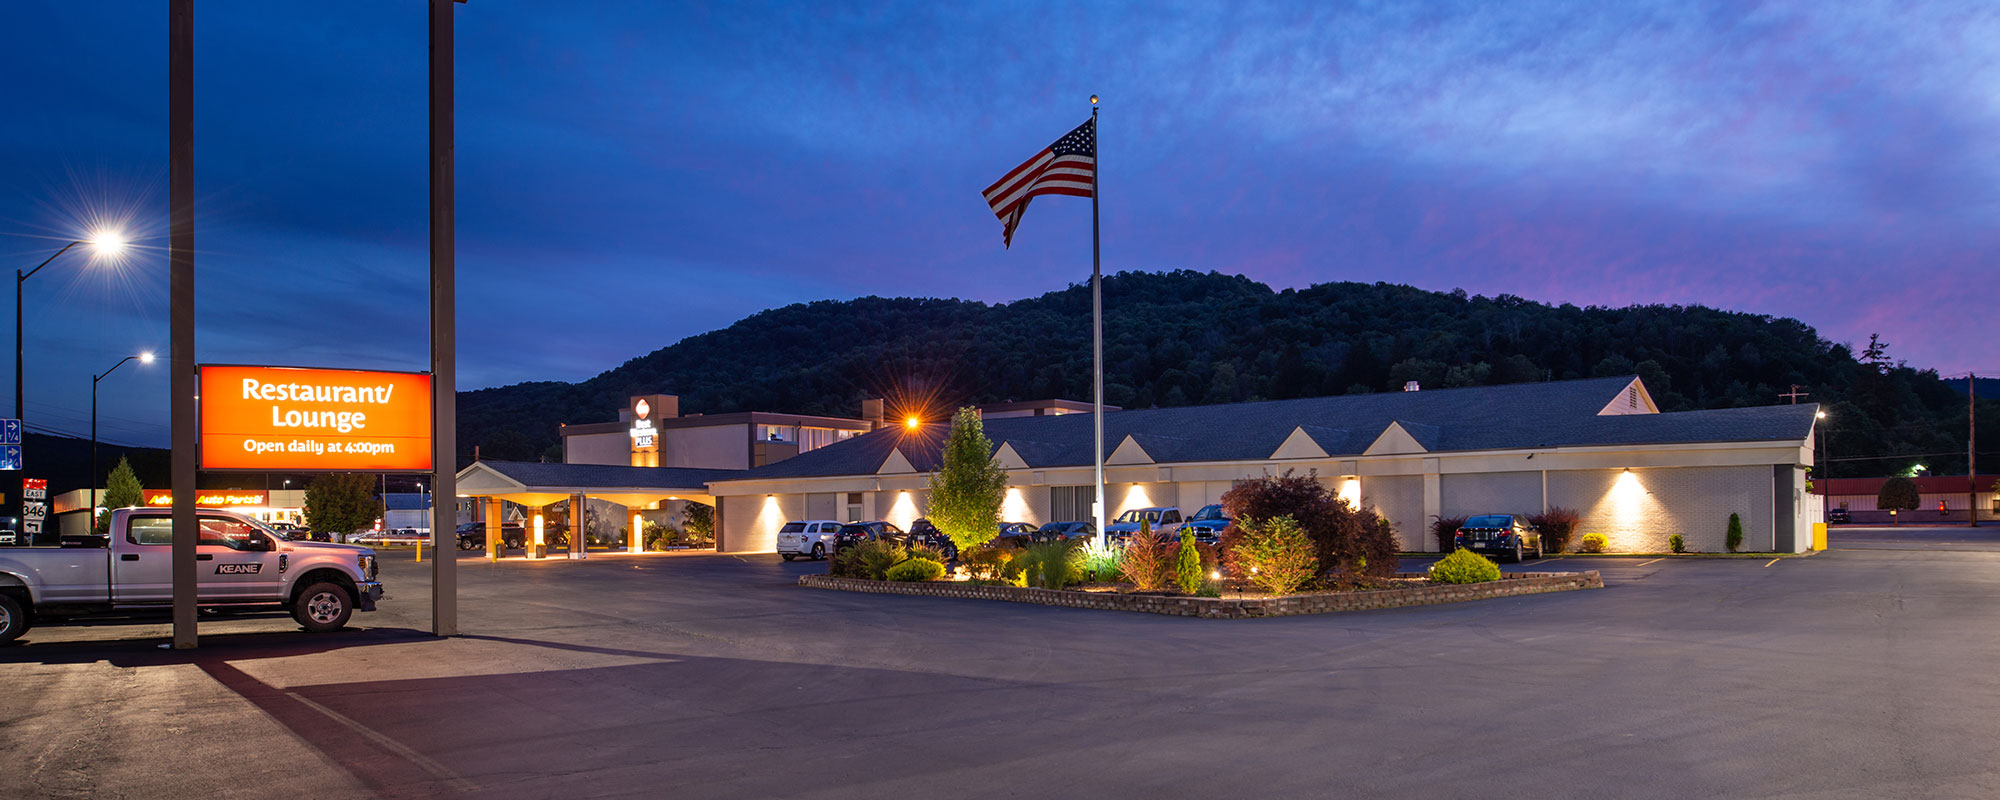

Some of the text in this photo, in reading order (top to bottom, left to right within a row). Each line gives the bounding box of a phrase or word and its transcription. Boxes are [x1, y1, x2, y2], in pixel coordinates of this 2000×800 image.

[242, 378, 394, 404] Restaurant/
[272, 406, 366, 433] Lounge
[635, 436, 653, 446] PLUS
[243, 439, 395, 456] Open daily at 4:00pm
[26, 489, 43, 497] EAST
[195, 495, 252, 505] Auto Parts
[23, 505, 45, 517] 346
[220, 564, 258, 573] KEANE
